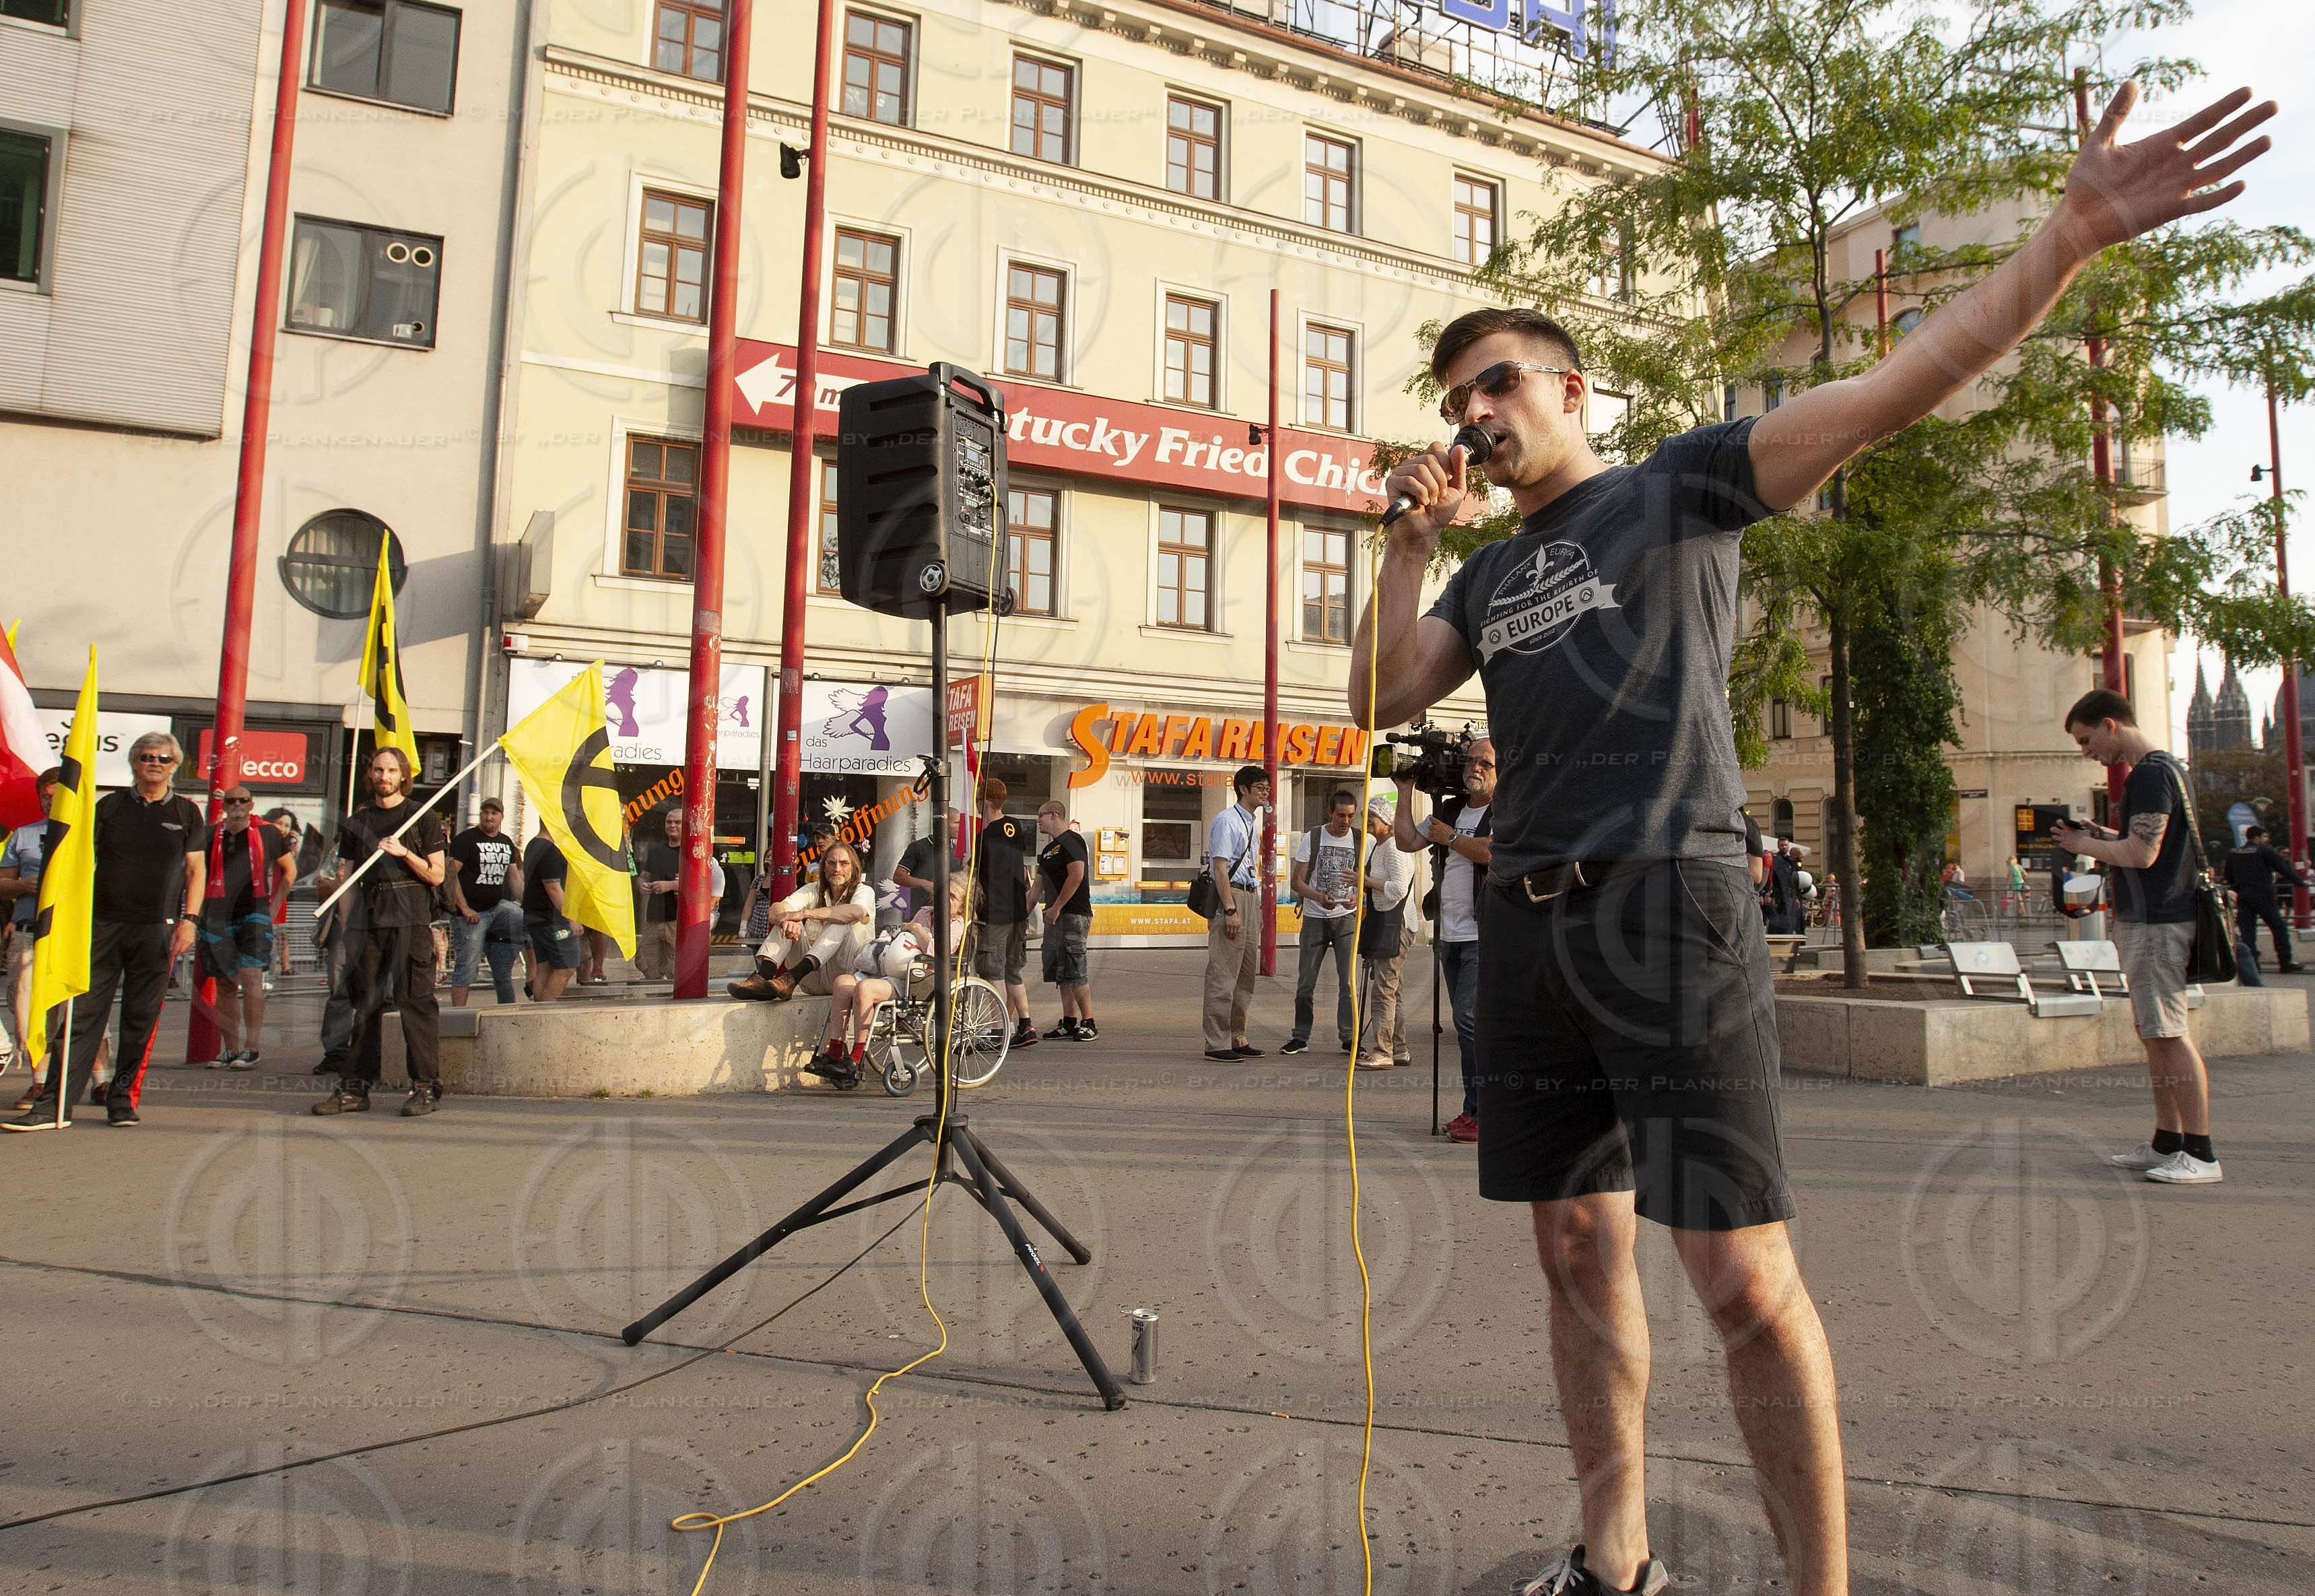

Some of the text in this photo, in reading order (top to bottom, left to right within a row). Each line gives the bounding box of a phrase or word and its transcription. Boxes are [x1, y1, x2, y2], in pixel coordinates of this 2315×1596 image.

[776, 374, 817, 397] 7
[1005, 407, 1387, 497] tucky Fried Chic
[1516, 599, 1533, 611] FOR
[1535, 592, 1551, 603] THE
[1587, 568, 1599, 578] OF
[1506, 594, 1574, 638] EUROPE
[947, 683, 972, 711] TAFA
[948, 710, 976, 732] REISEN
[806, 735, 828, 747] das
[1067, 702, 1211, 789] STAFA
[240, 754, 298, 778] ecco
[800, 752, 911, 772] Haarparadies
[1131, 769, 1234, 787] www.stafa
[479, 852, 510, 864] NEVE
[1025, 1244, 1041, 1266] PROEL
